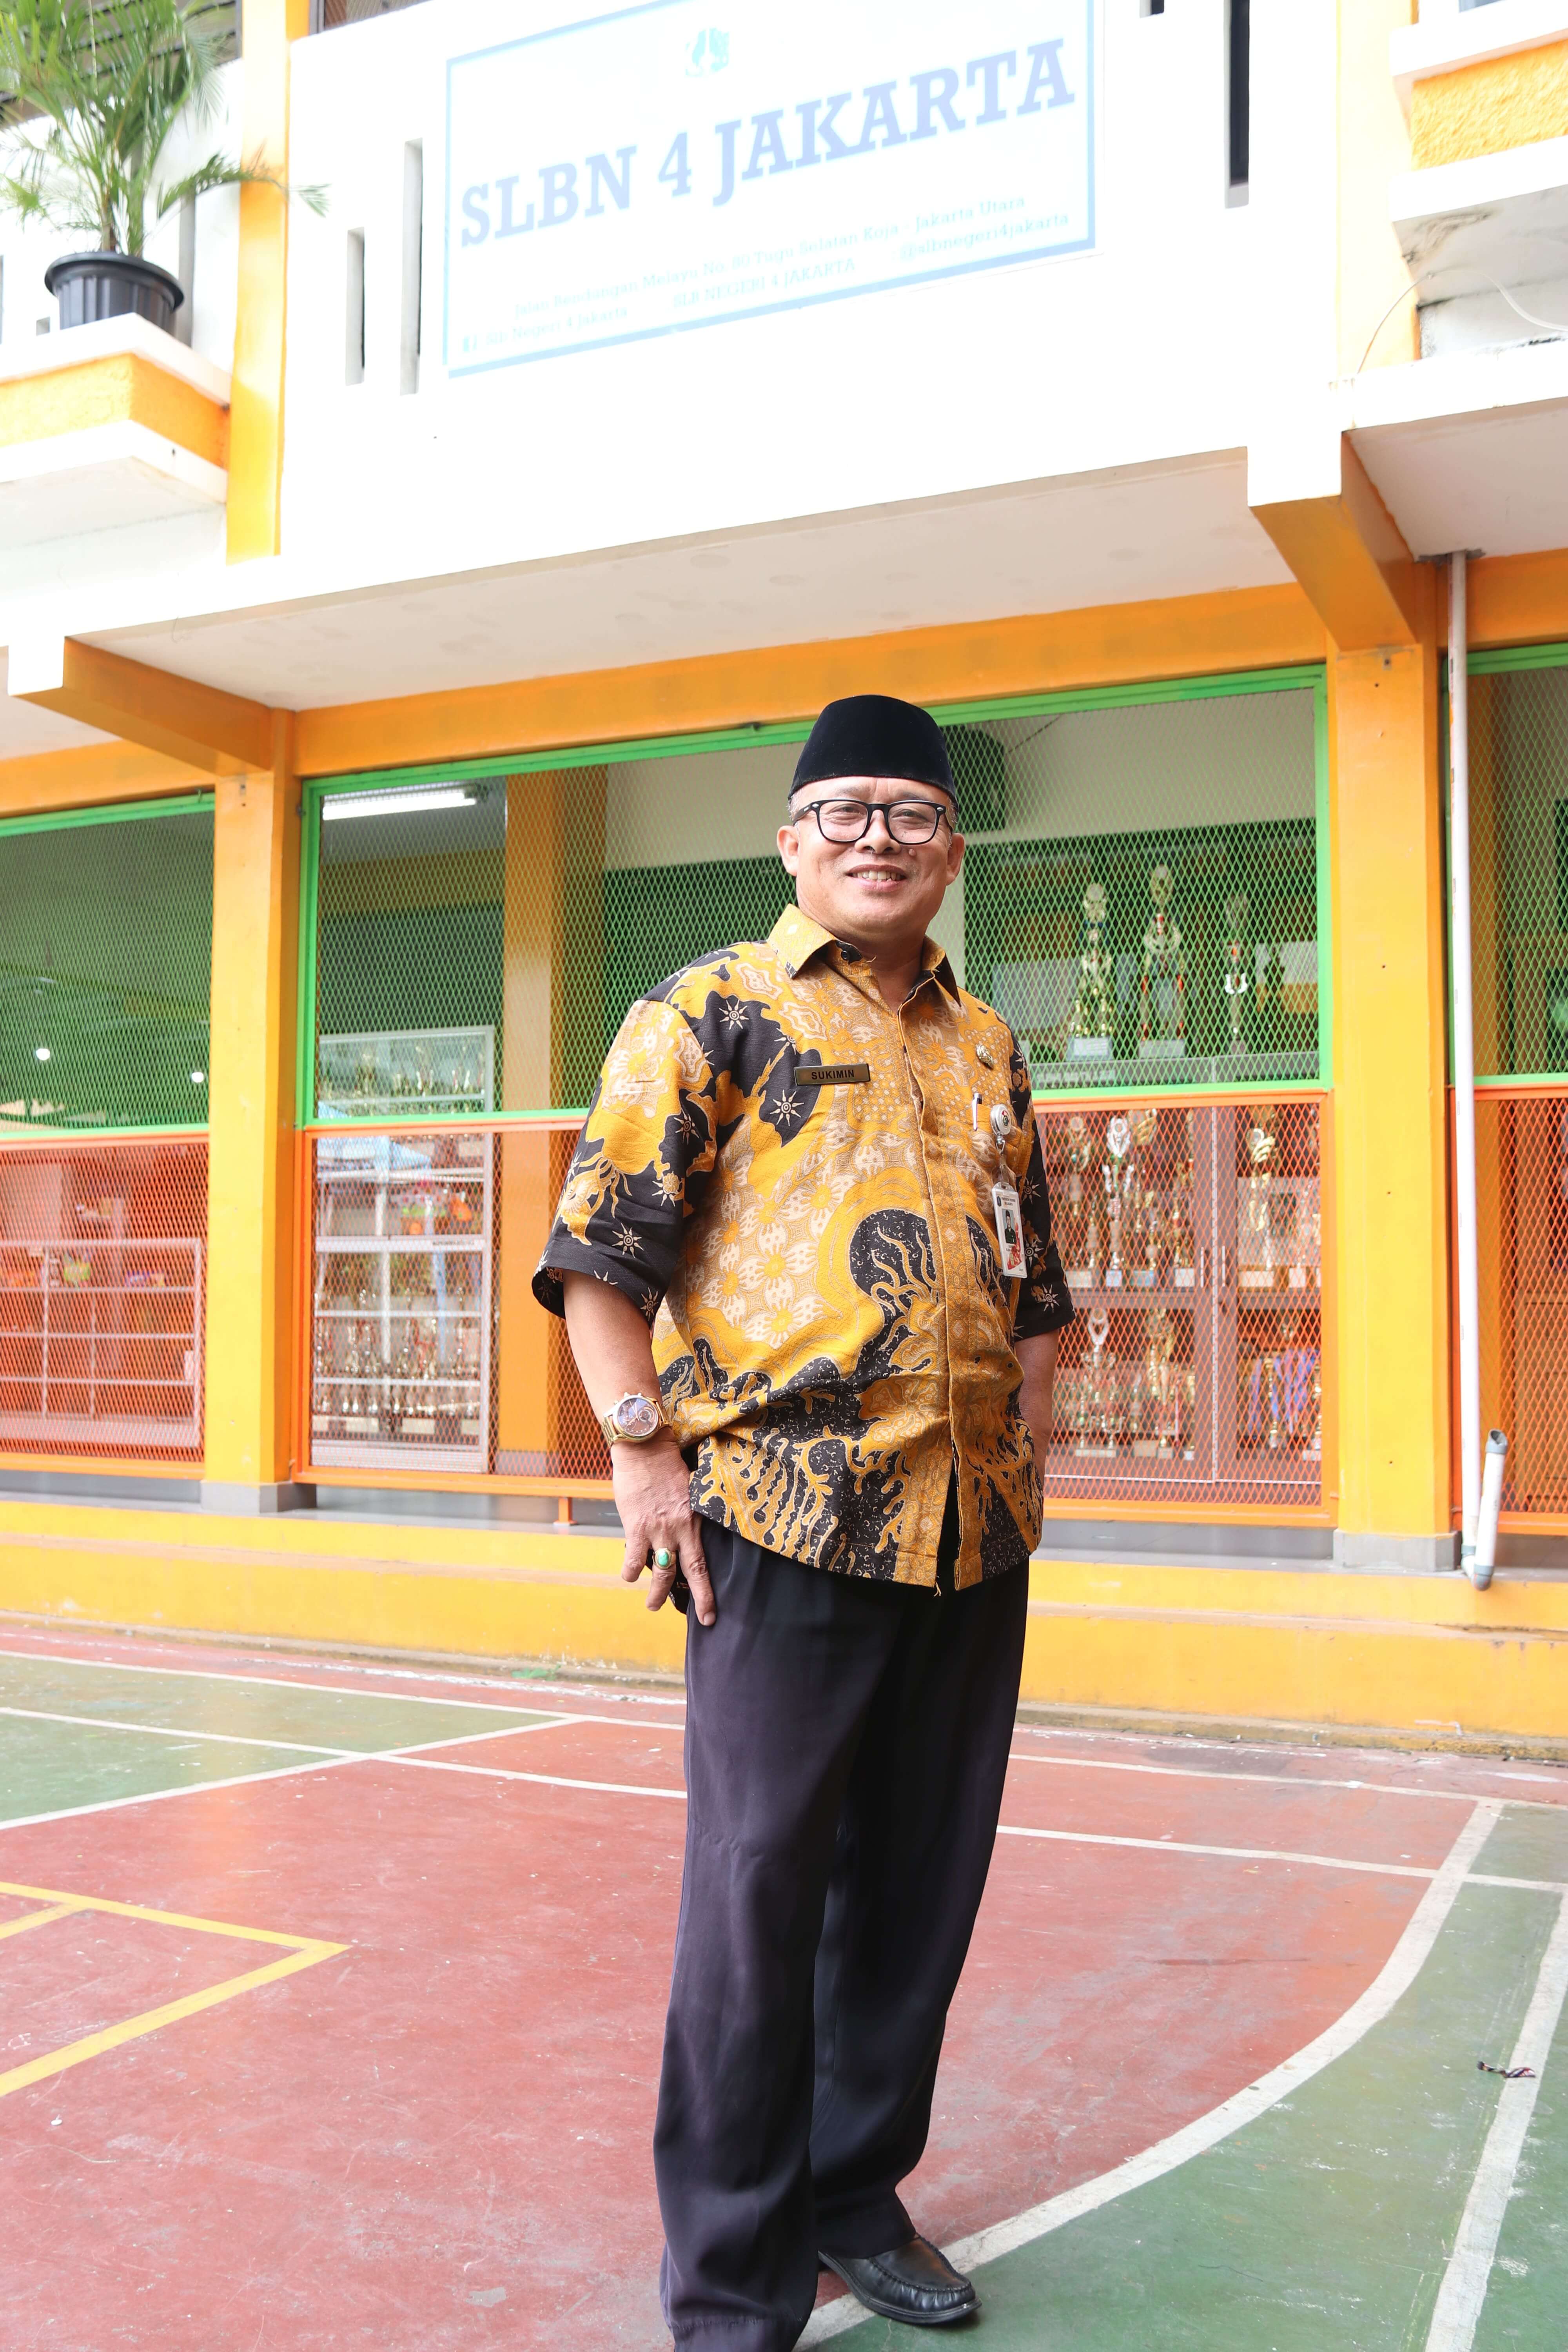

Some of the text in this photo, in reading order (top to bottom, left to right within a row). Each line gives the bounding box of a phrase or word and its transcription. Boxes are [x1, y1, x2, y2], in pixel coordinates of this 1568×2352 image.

[461, 37, 1076, 247] SLBN 4 JAKARTA
[642, 270, 698, 289] Melayu
[753, 247, 794, 264] Tugu
[862, 224, 899, 242] Koja
[915, 207, 974, 233] Jakarta
[979, 195, 1025, 216] Utara
[784, 257, 855, 289] JAKARTA
[577, 307, 628, 331] Jakarta
[811, 1069, 855, 1080] SUKIMIN
